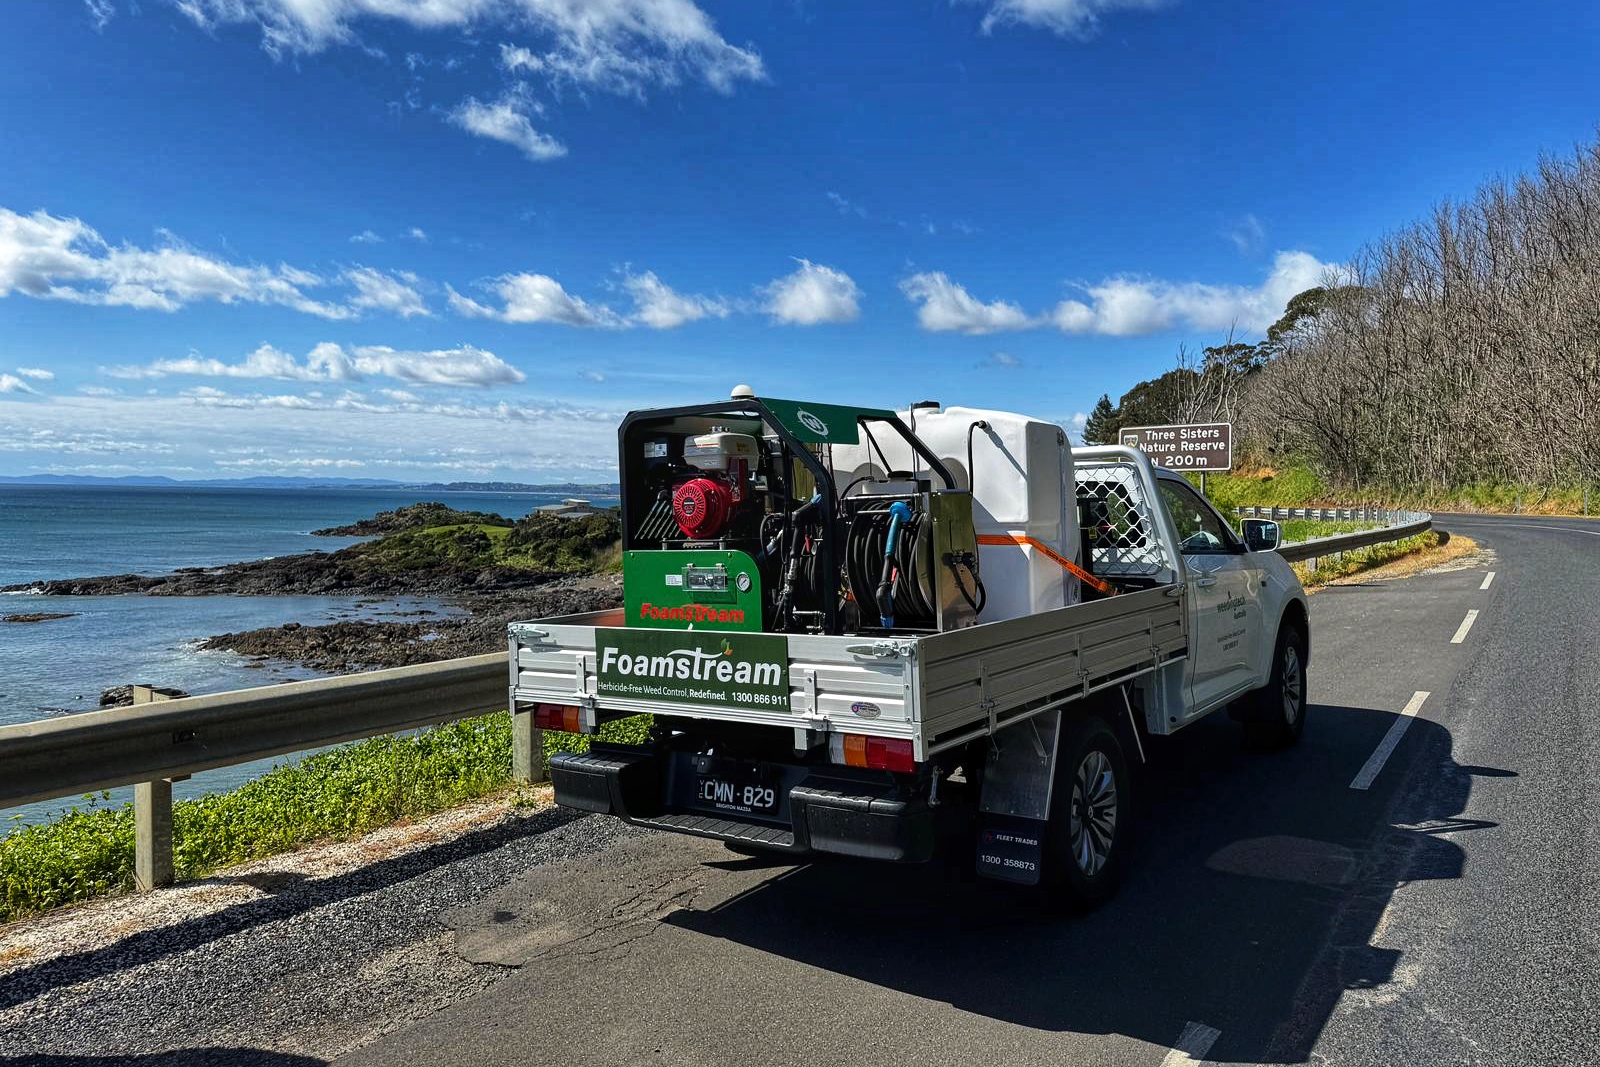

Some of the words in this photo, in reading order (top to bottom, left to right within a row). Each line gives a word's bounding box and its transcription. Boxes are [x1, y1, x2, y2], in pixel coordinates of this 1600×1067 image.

[1145, 430, 1175, 440] Three
[1180, 428, 1220, 439] Sisters
[1139, 442, 1176, 453] Nature
[1181, 440, 1226, 451] Reserve
[640, 602, 745, 623] Foamstream
[601, 647, 781, 686] Foamstream
[598, 681, 642, 693] Herbicide-Free
[643, 684, 662, 694] Weed
[662, 686, 688, 698] Control,
[689, 689, 727, 700] Redefined.
[731, 692, 752, 702] 1300
[753, 694, 770, 704] 866
[772, 695, 787, 705] 911
[704, 781, 734, 803] CMN
[743, 786, 775, 808] 829
[1015, 837, 1038, 846] TRADES
[981, 855, 1001, 864] 1300
[1003, 858, 1035, 870] 358873
